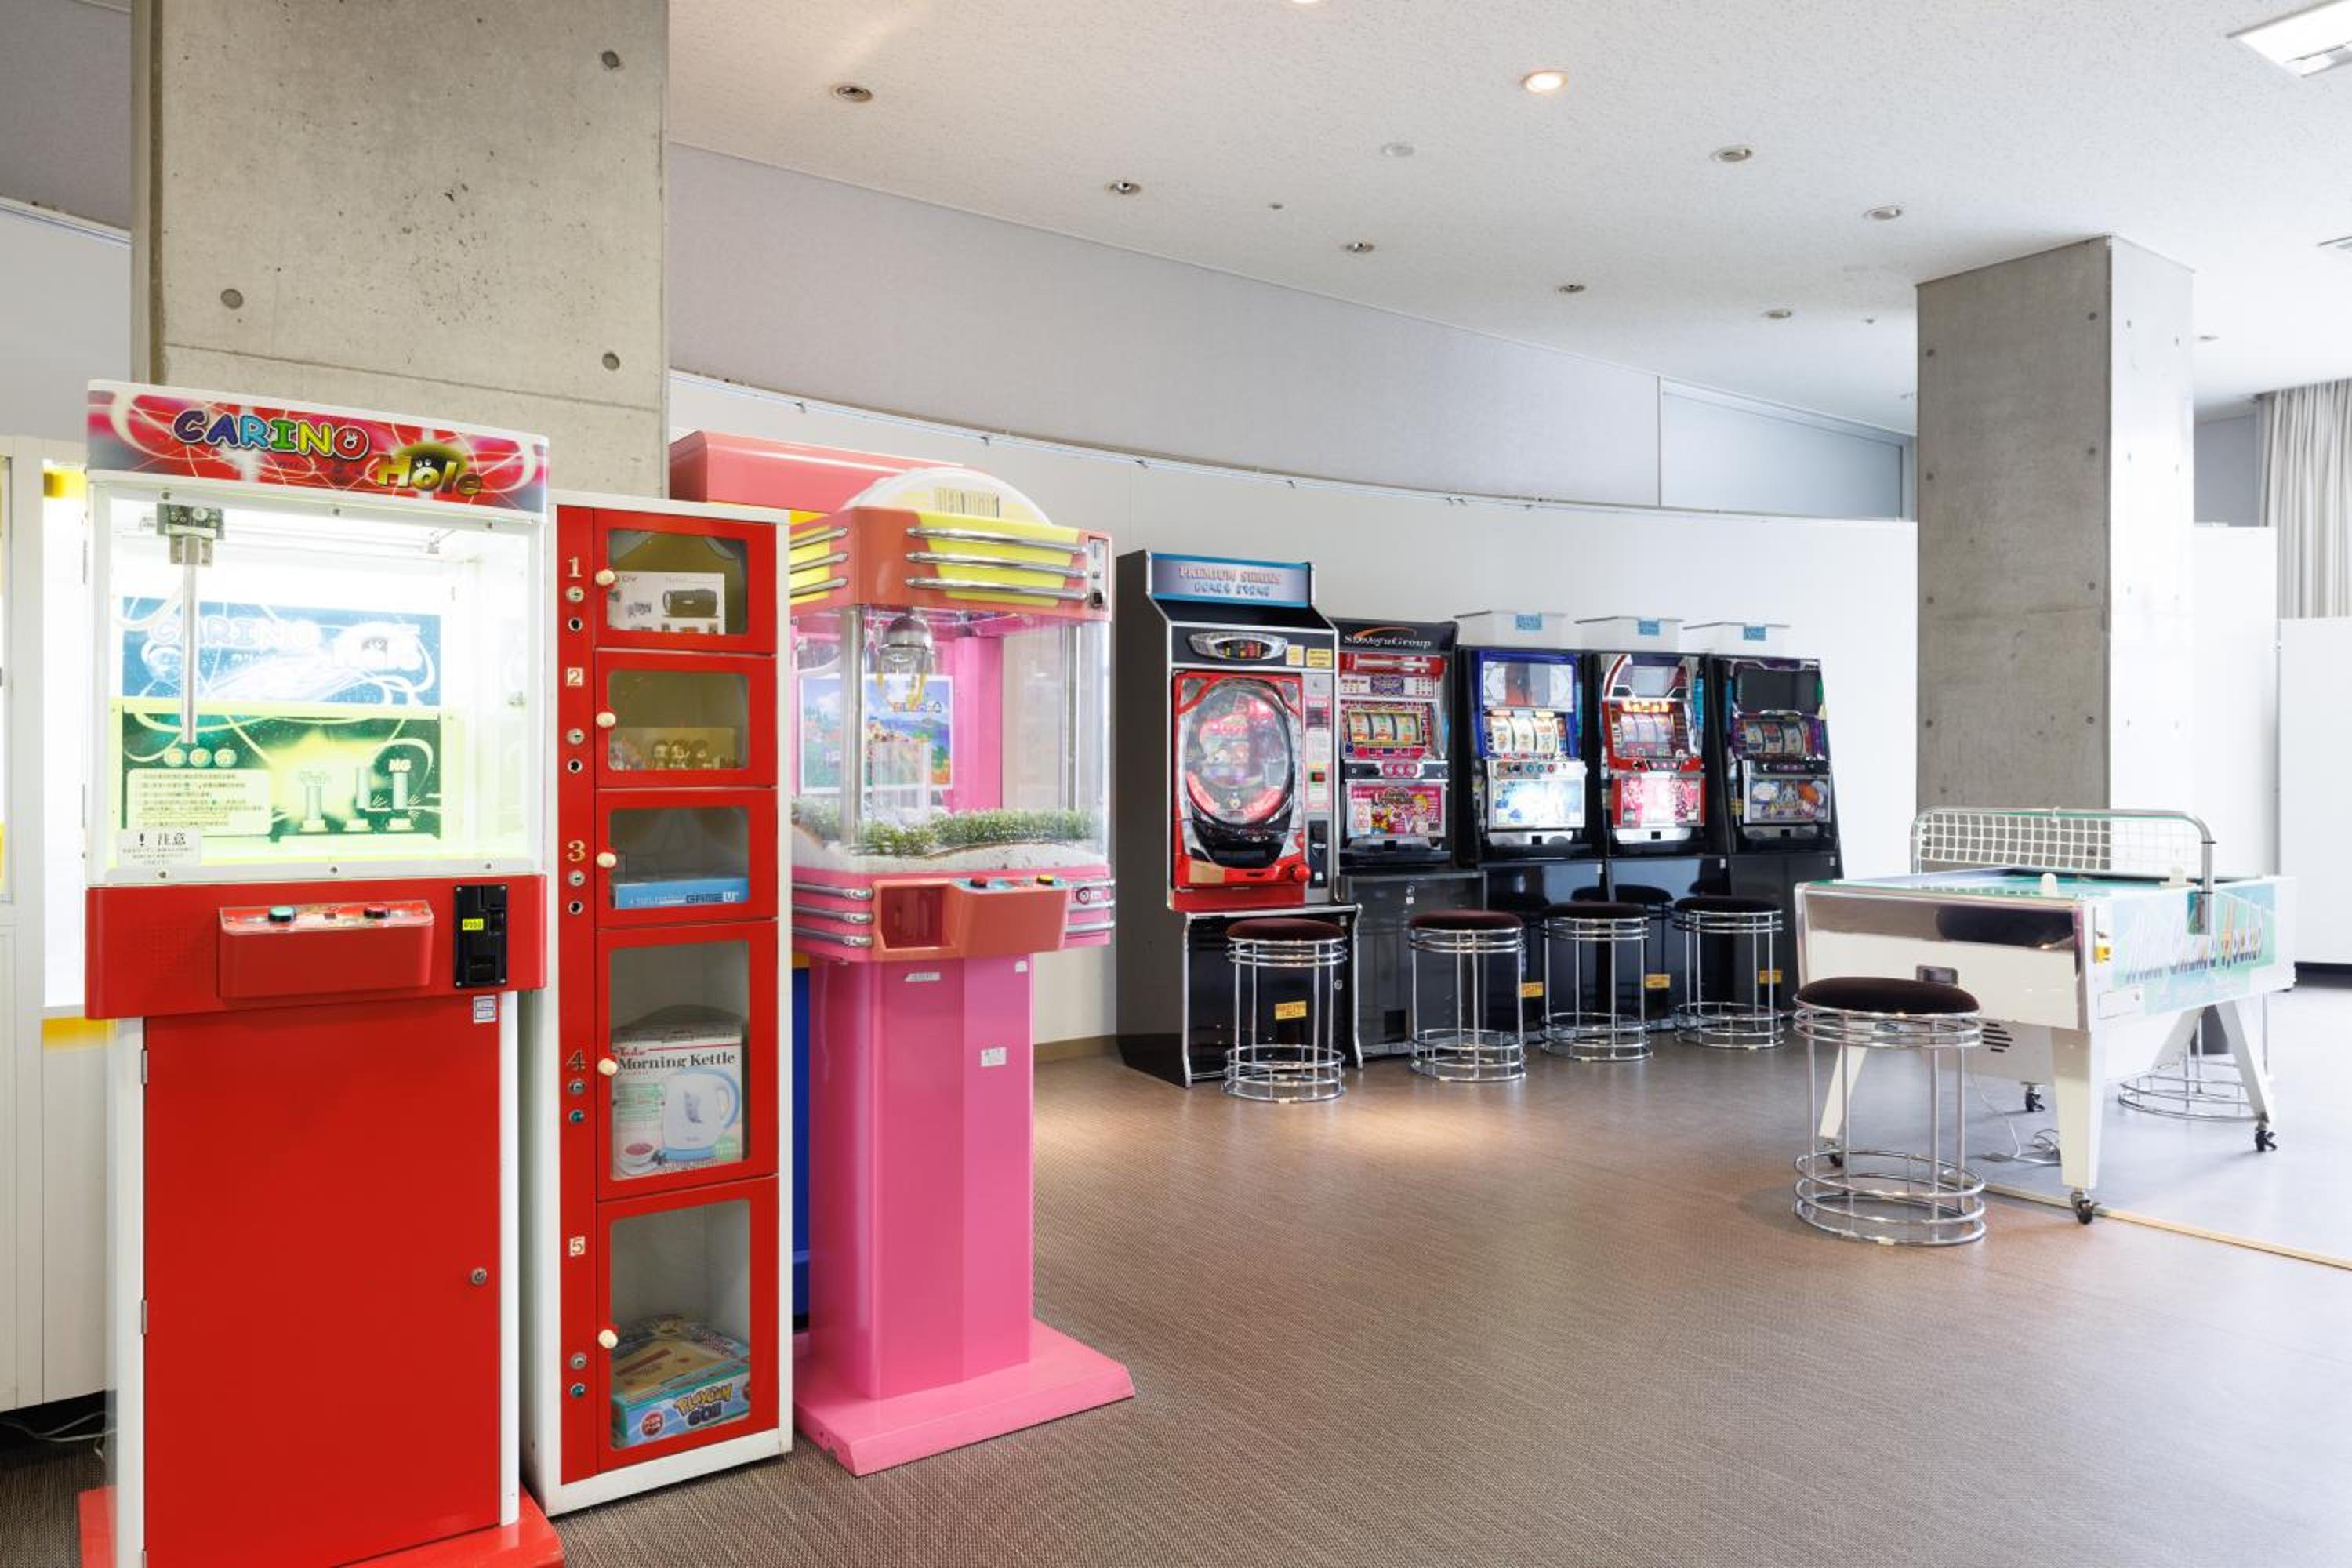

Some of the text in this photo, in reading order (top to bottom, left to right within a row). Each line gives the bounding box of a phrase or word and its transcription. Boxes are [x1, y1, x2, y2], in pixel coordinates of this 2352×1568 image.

[173, 410, 369, 460] CARINO
[376, 454, 483, 495] Hole
[568, 556, 583, 579] 1
[1178, 564, 1236, 582] PREMIUM
[568, 669, 582, 685] 2
[566, 840, 586, 862] 3
[565, 1048, 586, 1072] 4
[618, 1051, 735, 1071] Morning Kettle
[571, 1237, 585, 1254] 5
